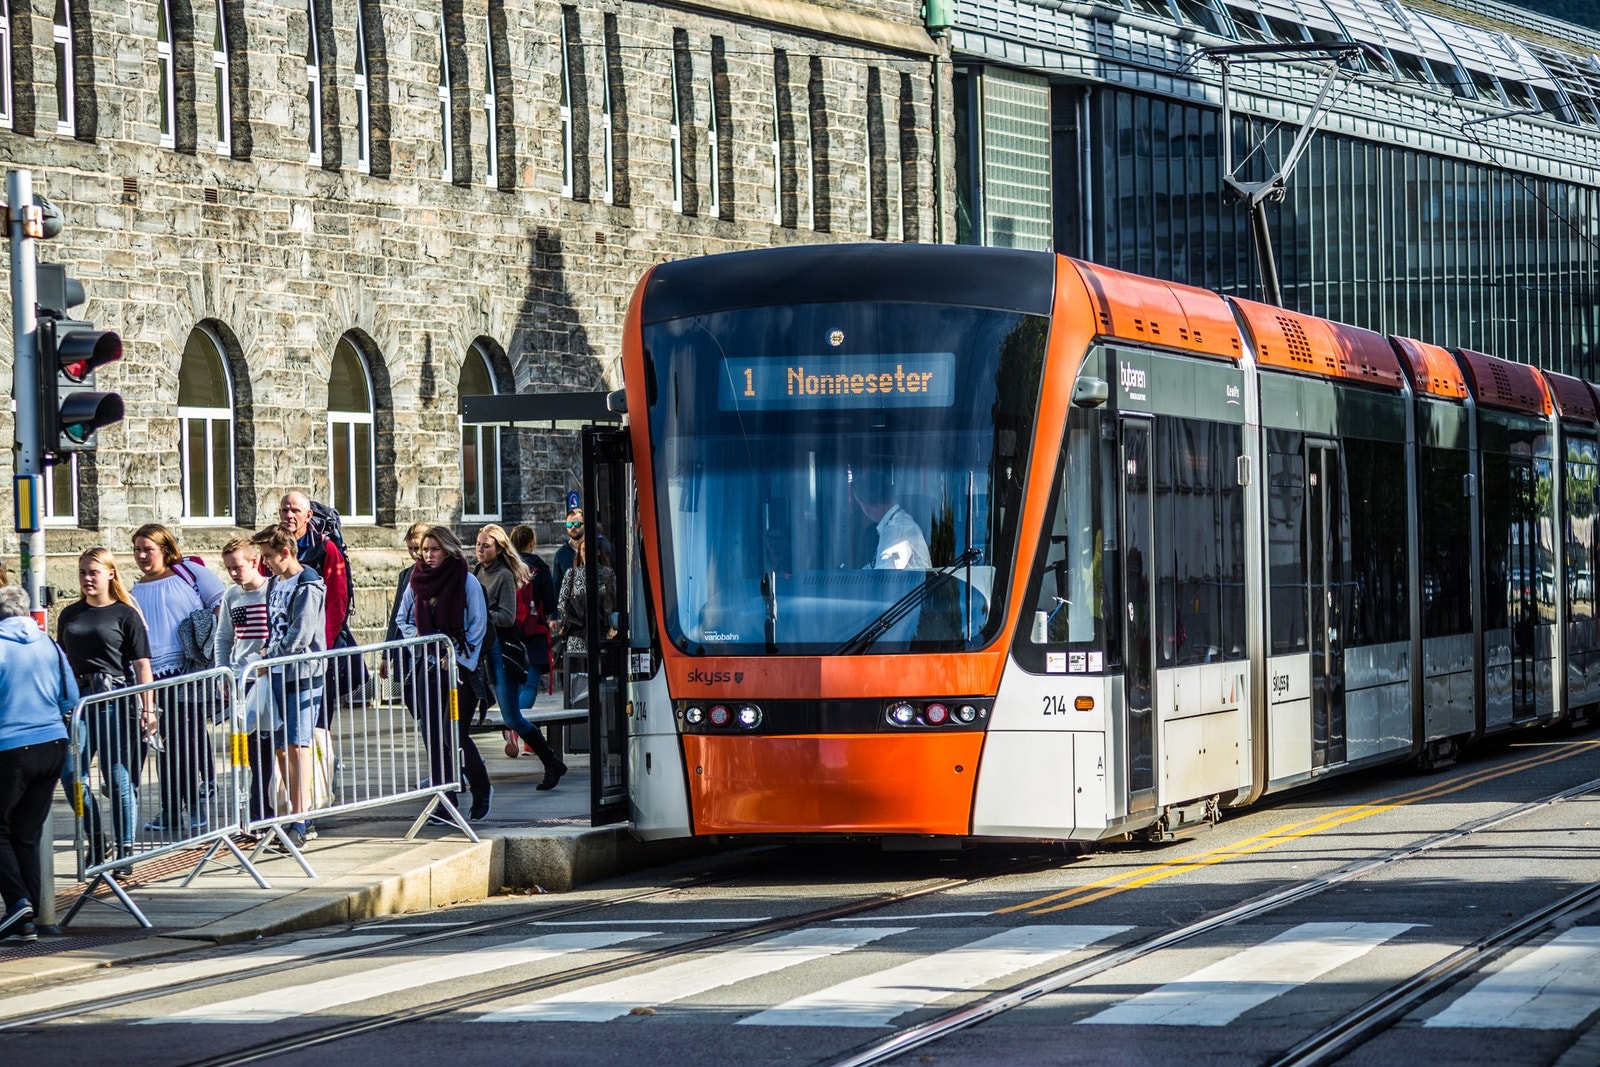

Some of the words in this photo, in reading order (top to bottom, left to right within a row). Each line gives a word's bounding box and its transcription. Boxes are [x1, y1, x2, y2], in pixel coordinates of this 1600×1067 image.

[744, 368, 756, 397] 1
[787, 364, 933, 396] Nonneseter
[1120, 360, 1146, 393] bybanen
[704, 632, 740, 641] variobahn
[687, 668, 731, 686] skyss
[635, 701, 647, 721] 214
[1042, 695, 1067, 716] 214
